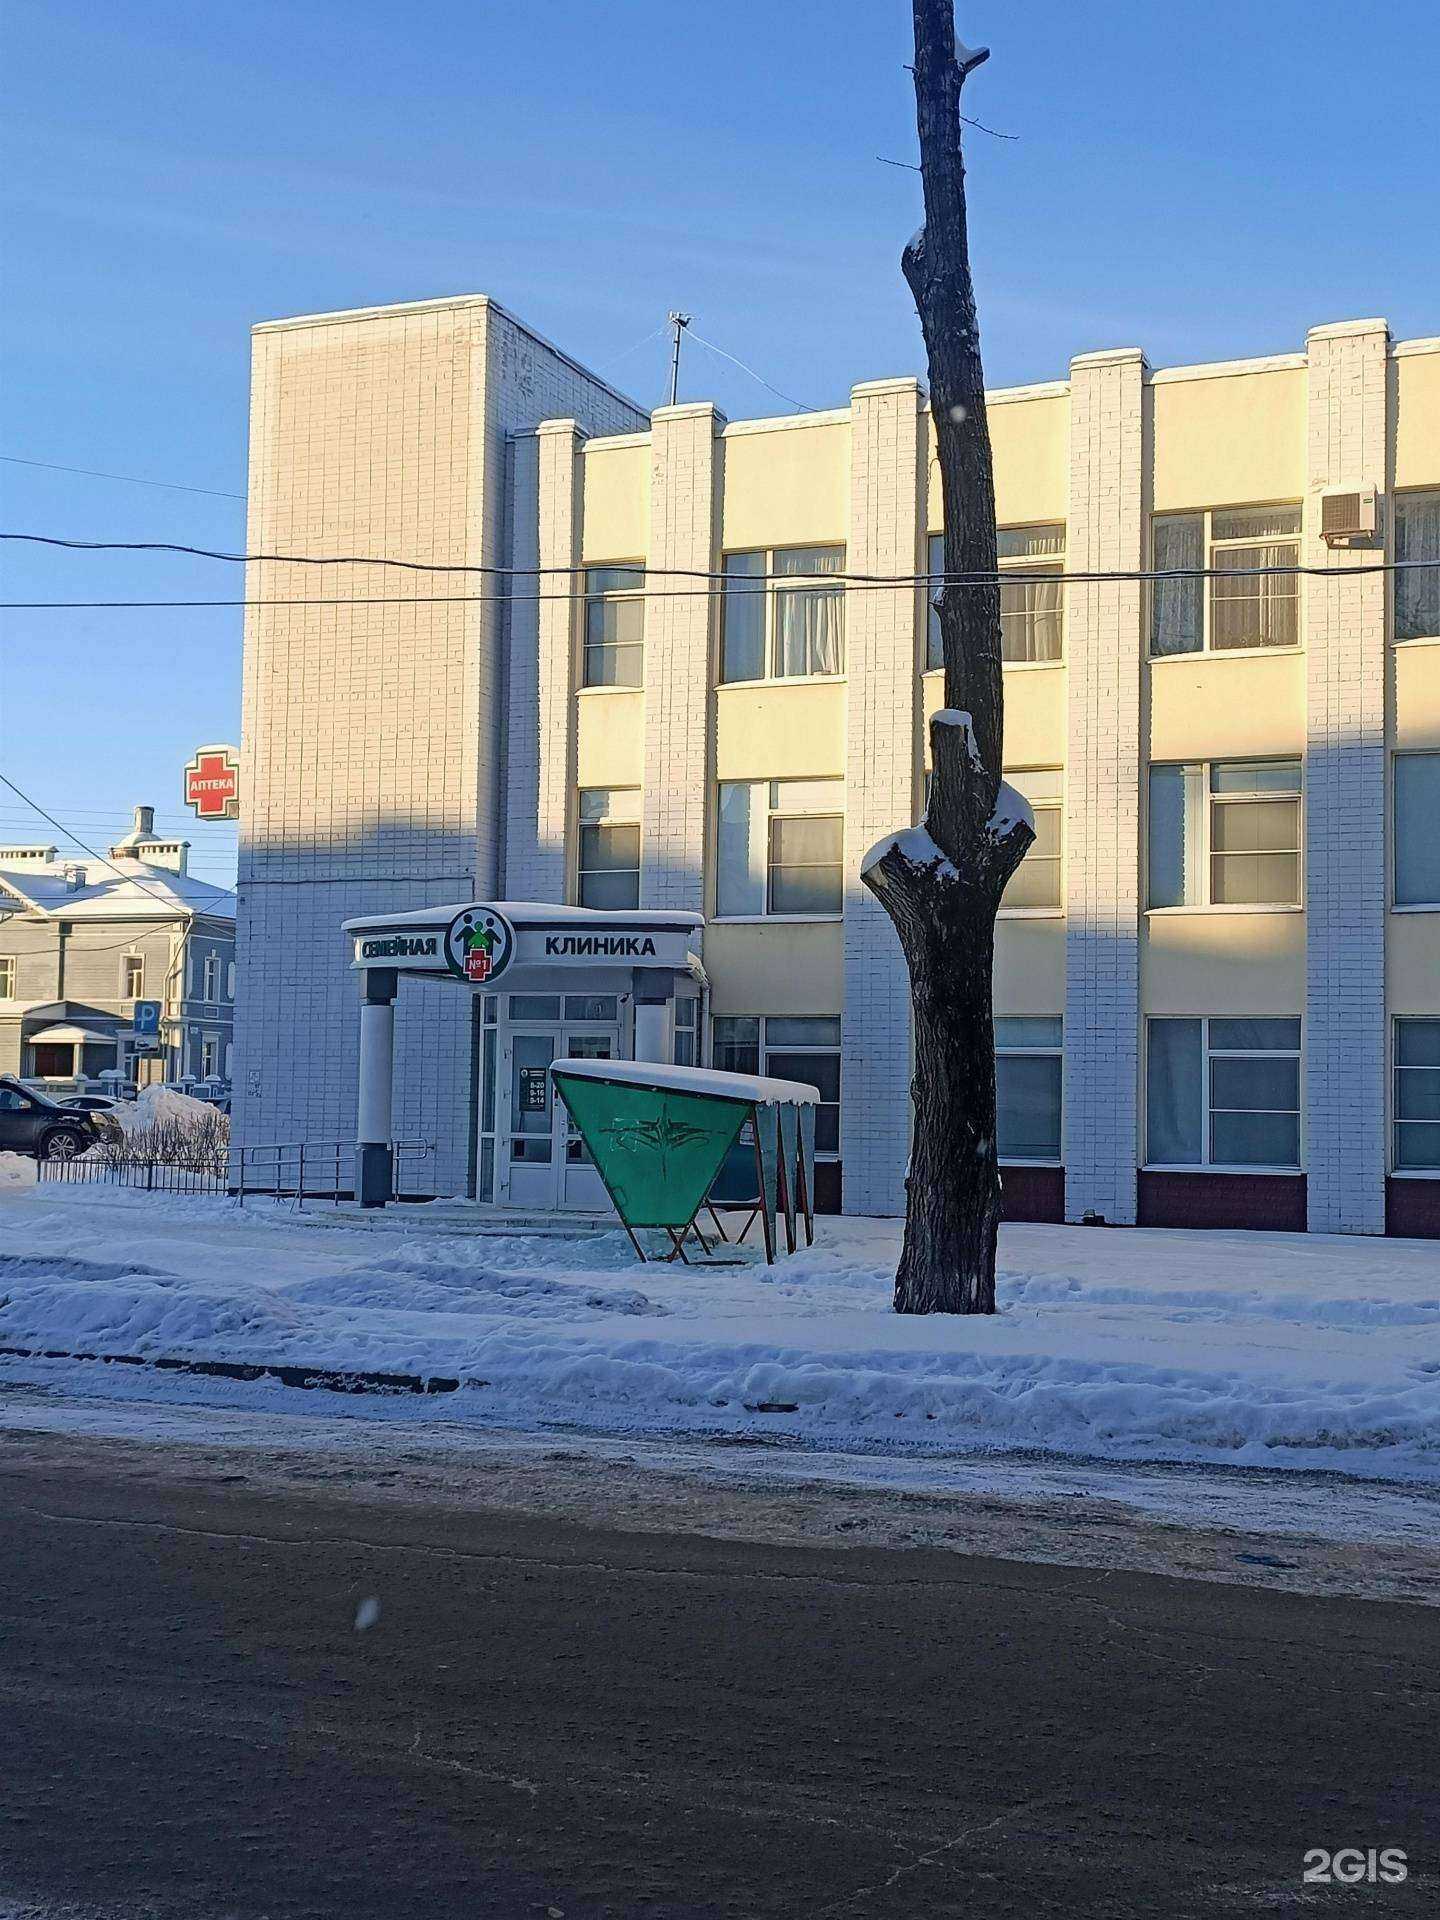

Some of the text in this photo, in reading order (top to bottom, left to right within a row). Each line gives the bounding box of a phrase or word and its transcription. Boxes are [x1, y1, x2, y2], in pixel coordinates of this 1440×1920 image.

[191, 778, 234, 791] АПТЕКА
[362, 936, 657, 958] СЕМЕЙНАЯ КЛИНИКА
[141, 1004, 155, 1030] P
